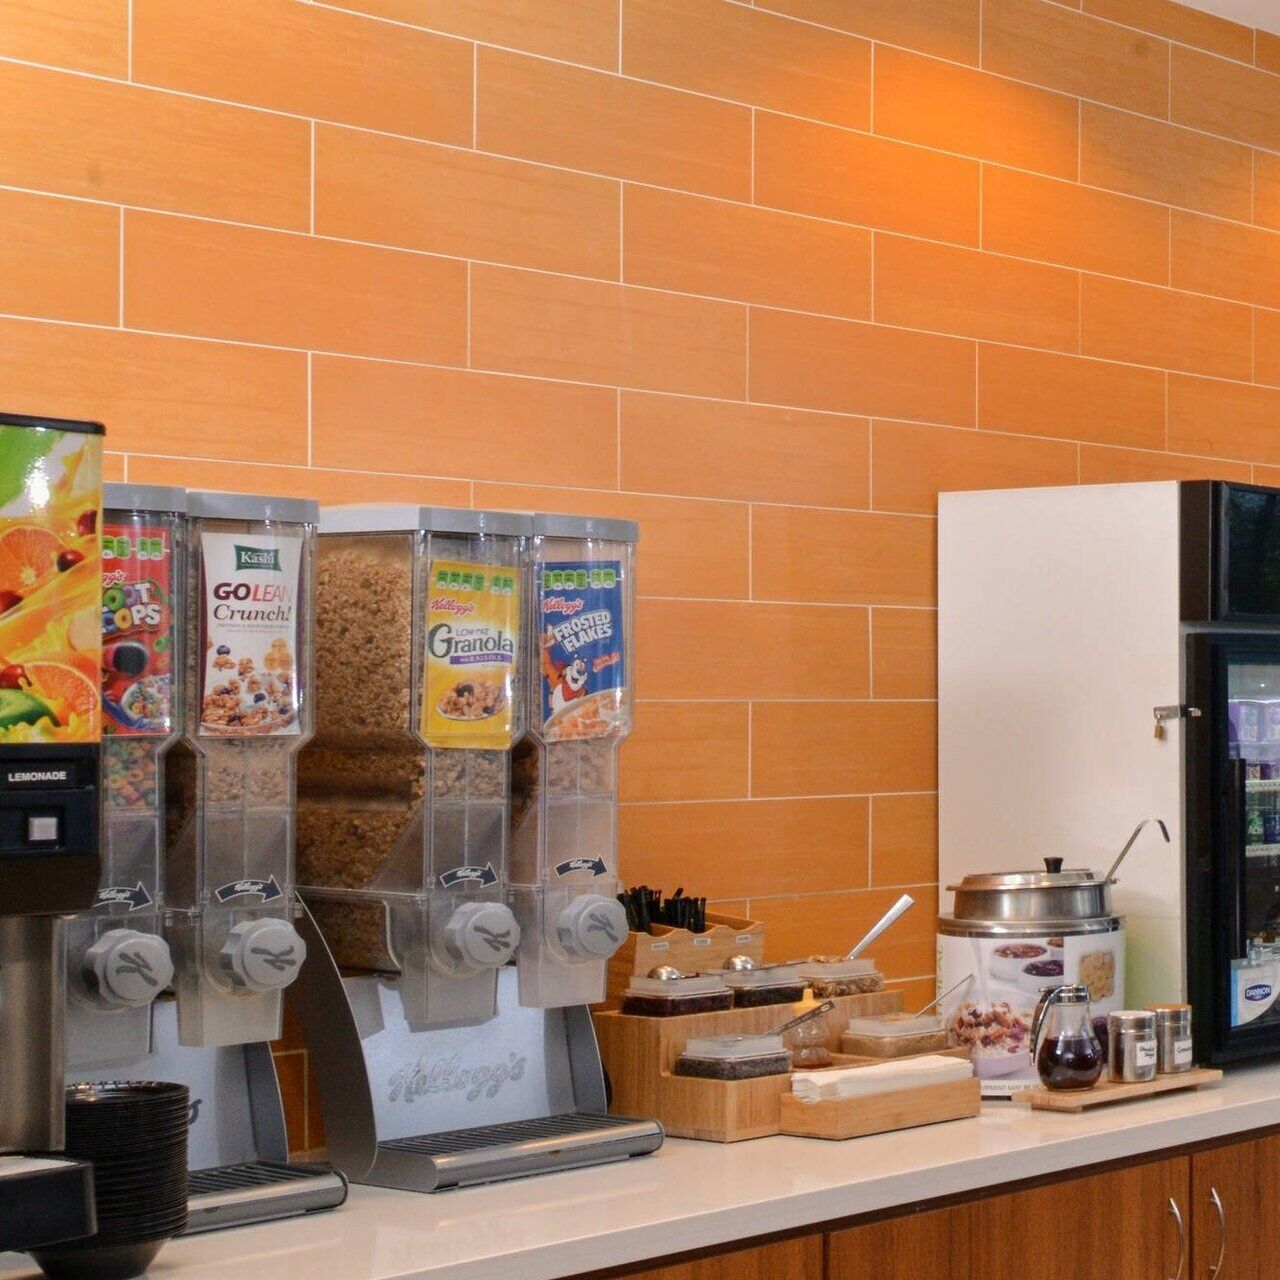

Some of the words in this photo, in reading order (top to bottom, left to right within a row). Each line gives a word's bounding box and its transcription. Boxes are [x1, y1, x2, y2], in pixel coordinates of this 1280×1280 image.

[240, 551, 275, 564] Kashi
[213, 603, 293, 622] Crunch!
[431, 597, 476, 616] Kellogg's
[543, 596, 584, 615] Kellogg's
[552, 609, 612, 641] FROSTED
[428, 622, 515, 659] Granola
[560, 622, 614, 654] FLAKES
[8, 771, 67, 781] LEMONADE
[1246, 986, 1271, 998] DANNON
[387, 1051, 527, 1103] Kellogg's
